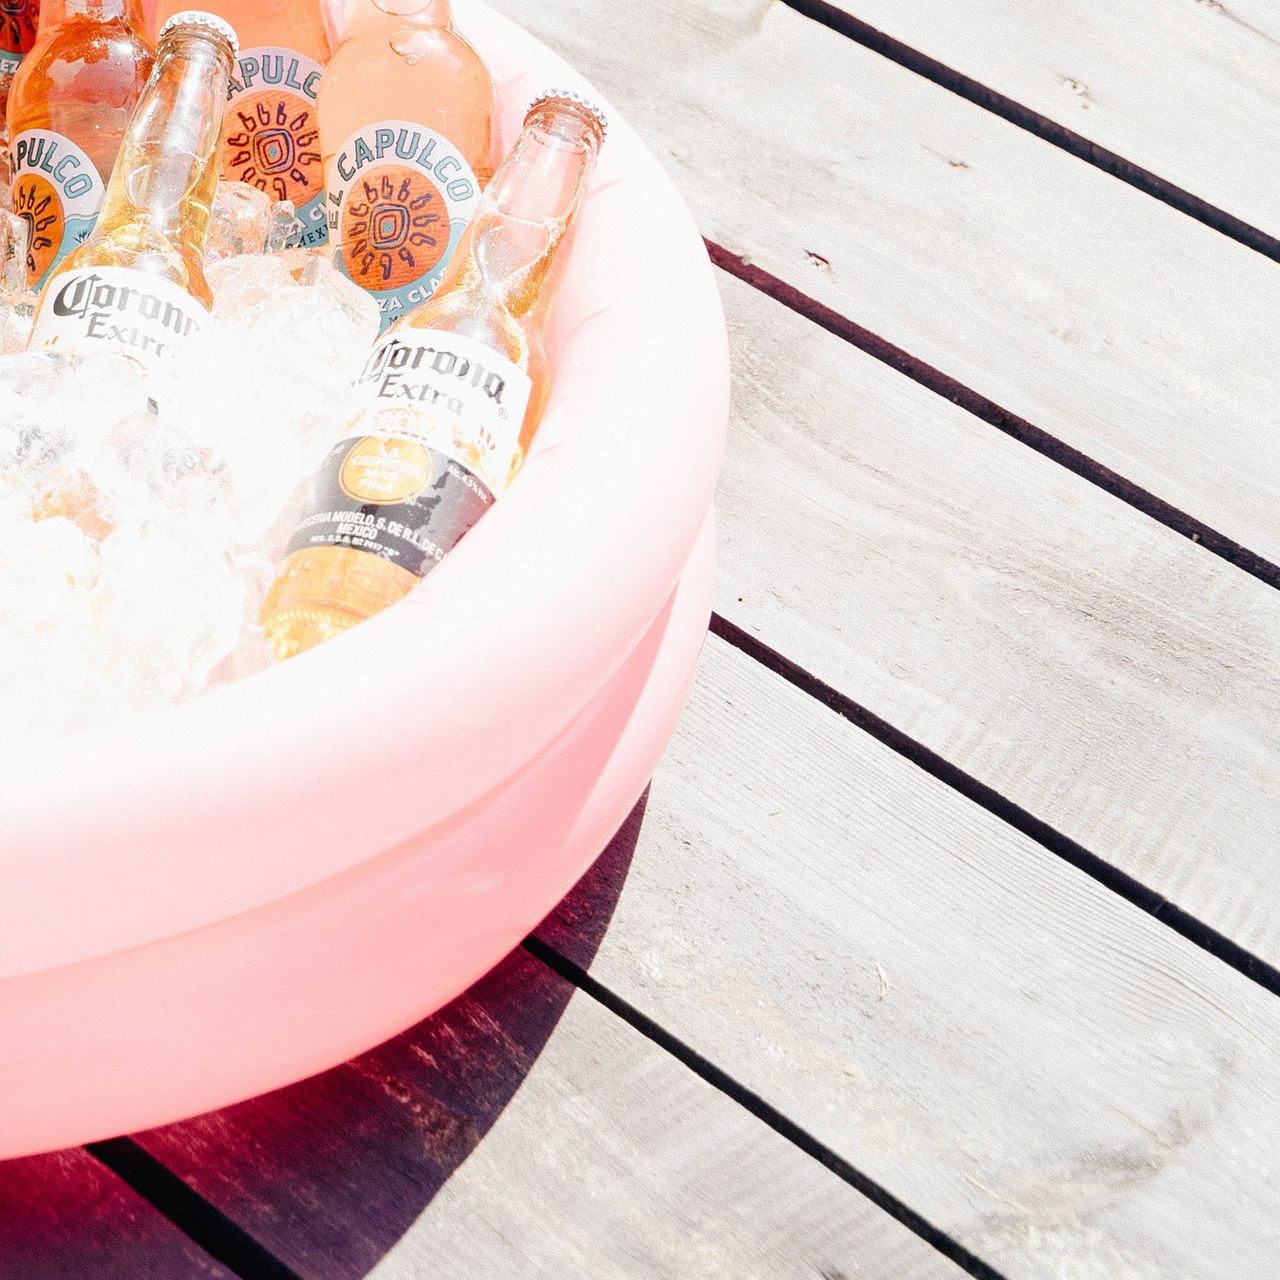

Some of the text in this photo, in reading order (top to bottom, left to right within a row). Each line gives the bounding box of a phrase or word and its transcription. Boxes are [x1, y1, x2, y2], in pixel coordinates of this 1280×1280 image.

[328, 128, 474, 230] EL CAPULCO
[376, 372, 466, 417] Extra
[336, 522, 378, 540] MEXICO
